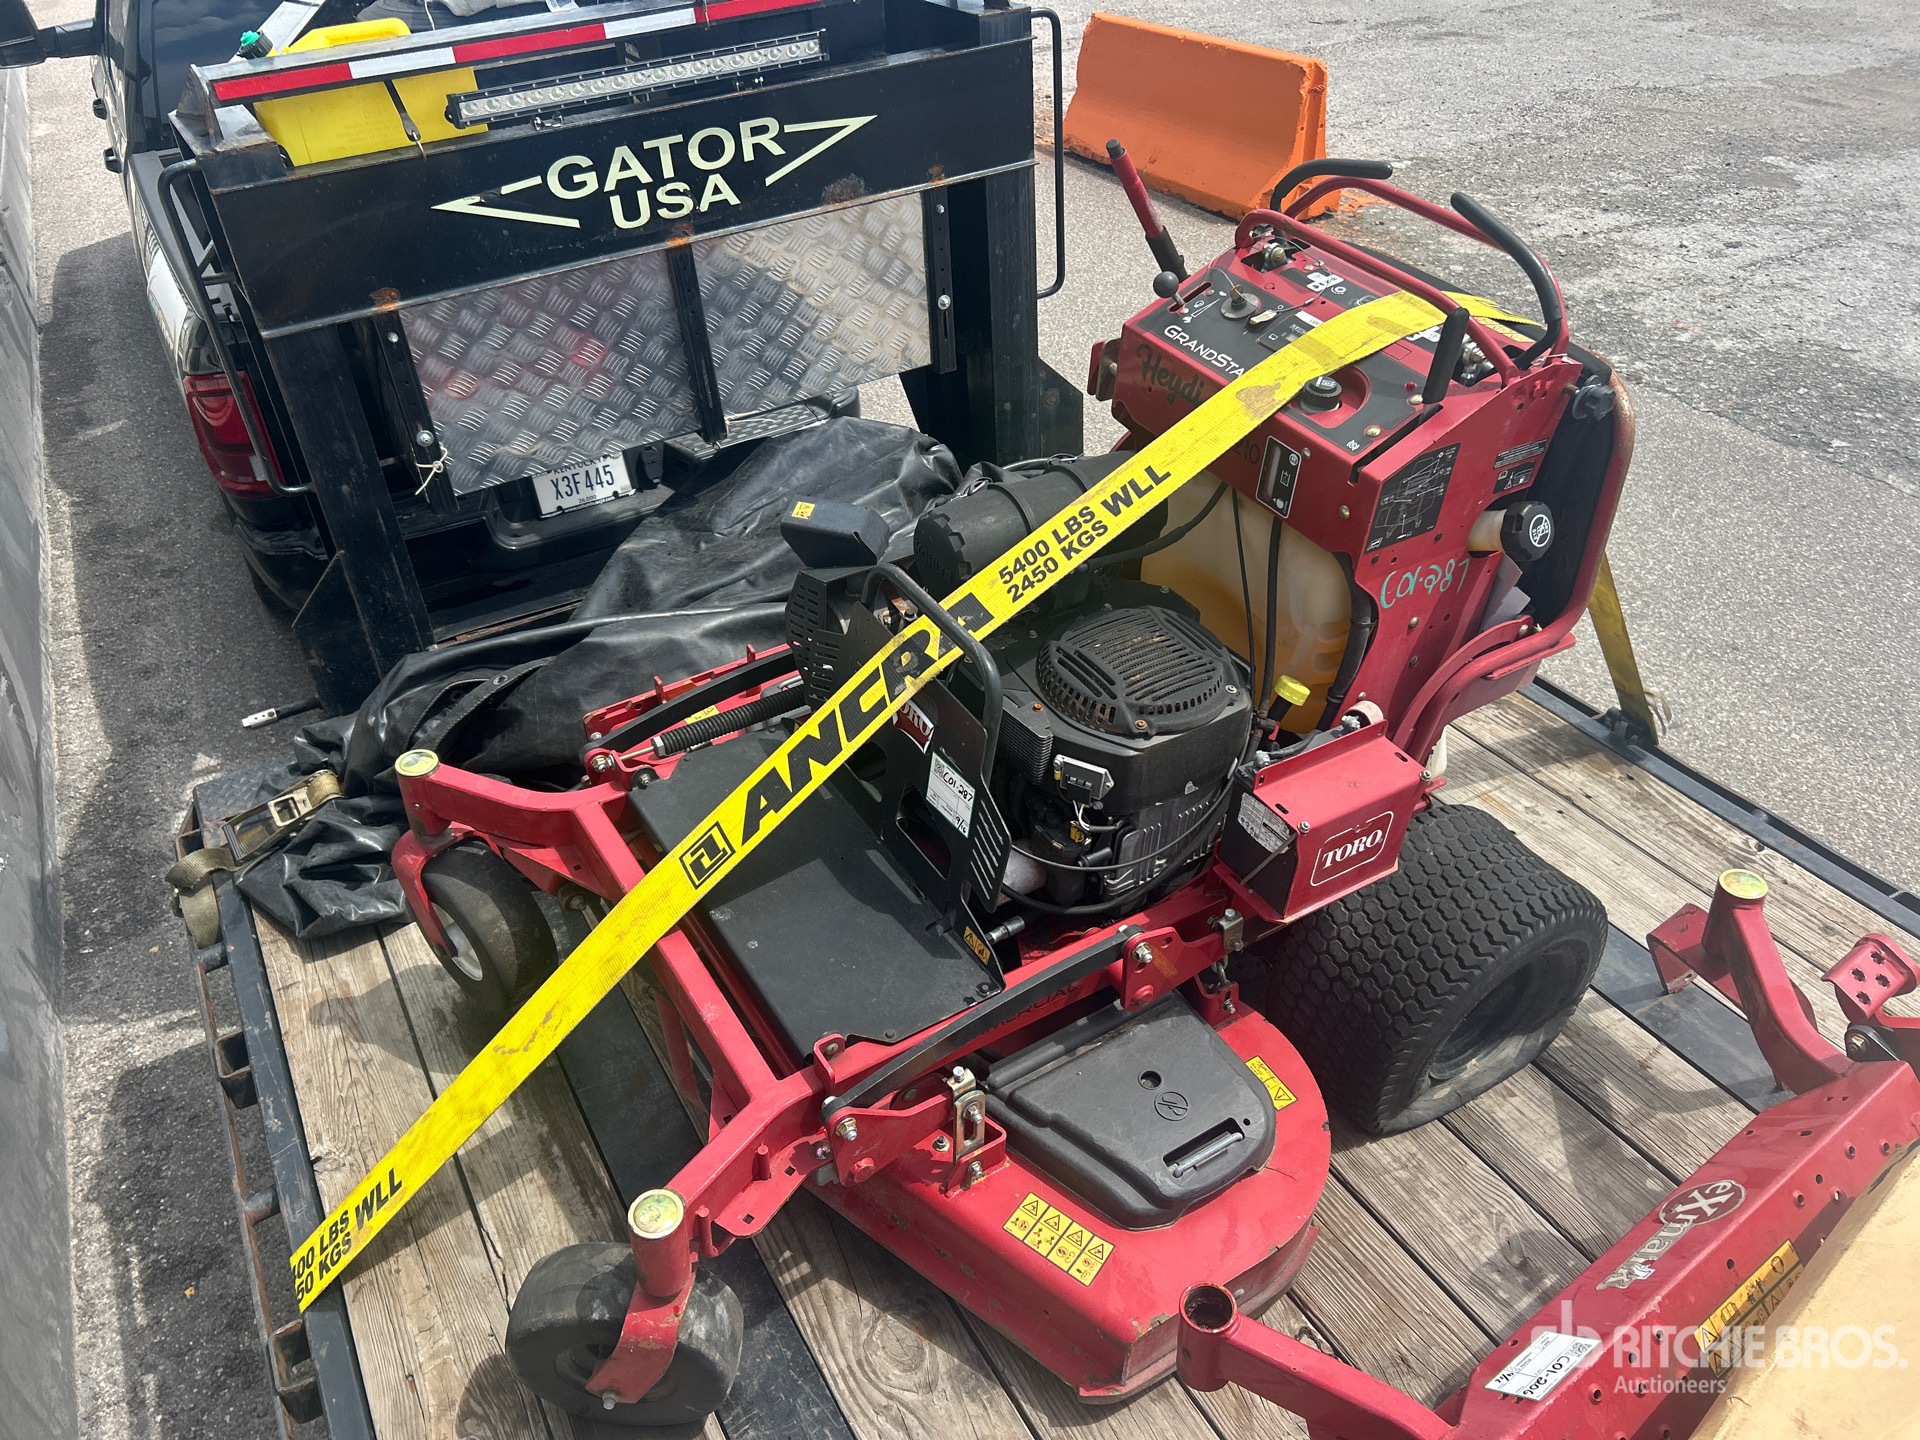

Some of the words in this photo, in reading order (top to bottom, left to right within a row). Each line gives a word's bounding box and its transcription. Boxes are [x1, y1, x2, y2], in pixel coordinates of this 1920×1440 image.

[546, 116, 786, 200] GATOR
[609, 173, 741, 230] USA
[999, 539, 1050, 585] 5400
[1051, 505, 1096, 545] LBS
[1100, 465, 1172, 518] WLL
[1006, 556, 1059, 603] 2450
[1060, 520, 1109, 561] KGS
[1321, 829, 1383, 870] TORO
[319, 1209, 350, 1257] LBS
[355, 1167, 403, 1231] WLL
[318, 1231, 352, 1281] KGS
